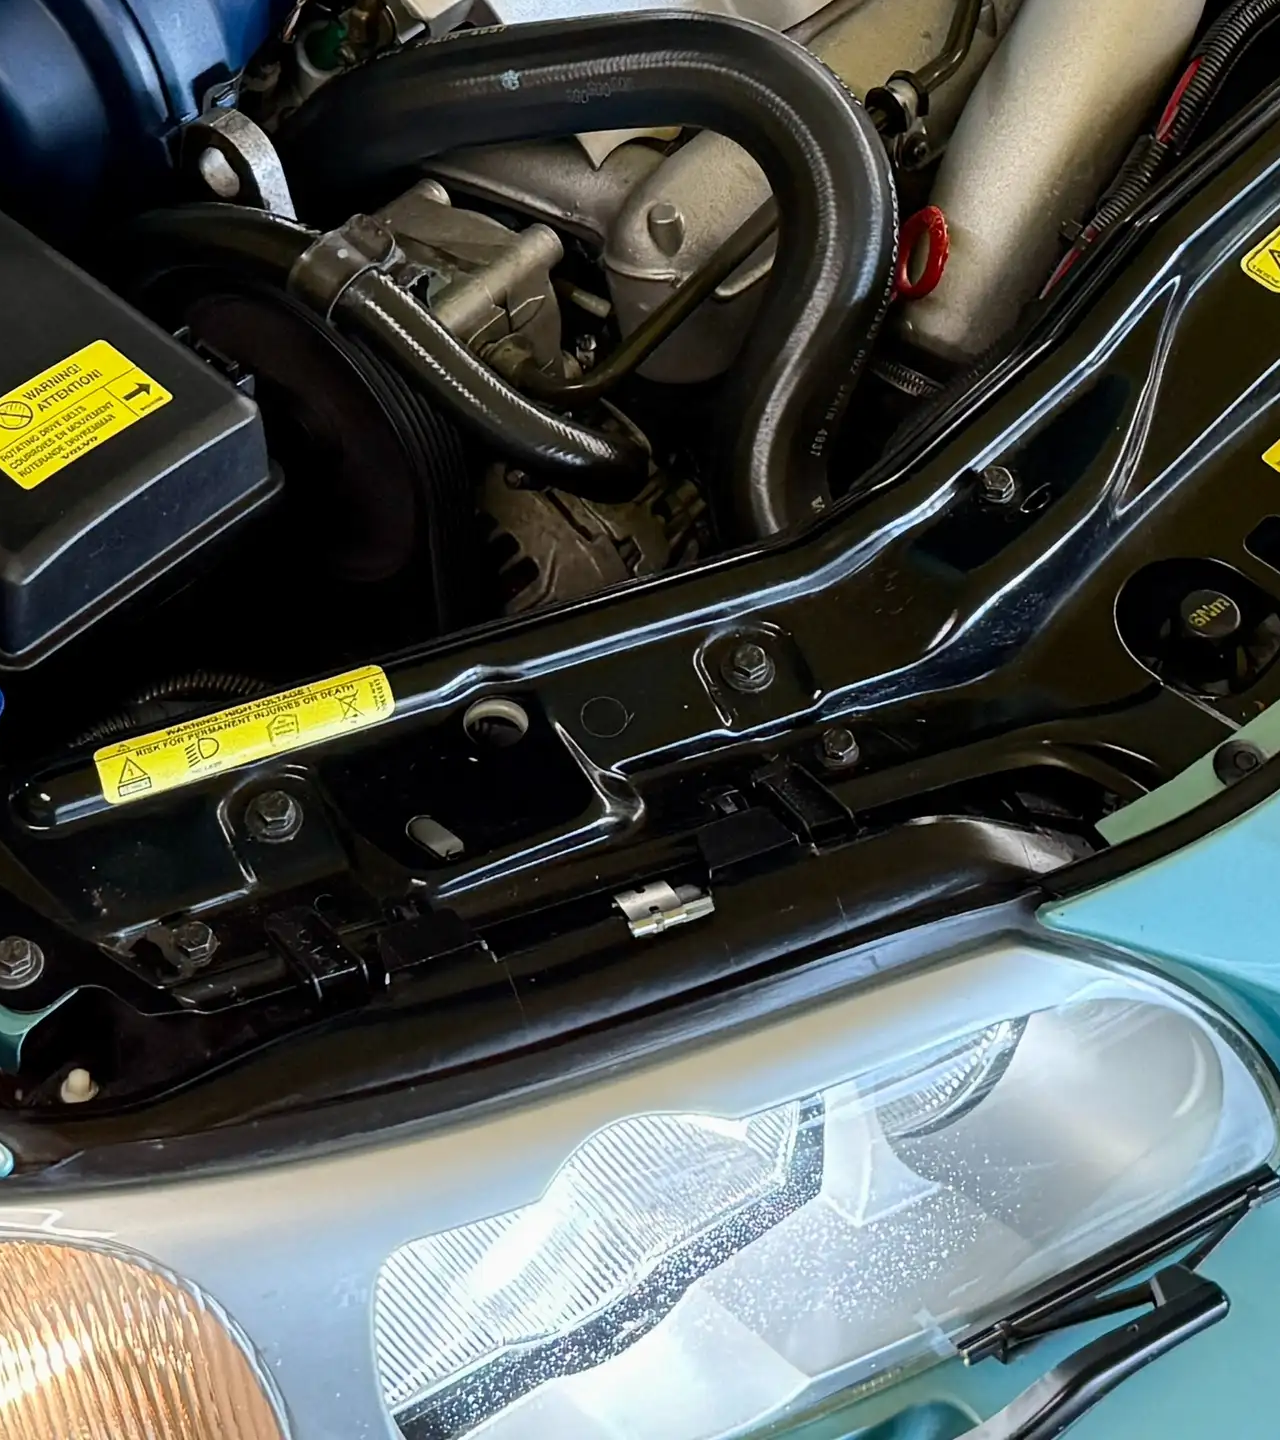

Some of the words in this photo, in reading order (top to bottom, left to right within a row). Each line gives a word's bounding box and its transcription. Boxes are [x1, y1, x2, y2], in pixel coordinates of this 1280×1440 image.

[22, 364, 82, 400] WARNING!
[37, 369, 103, 412] ATTENTION!
[0, 435, 40, 462] ROTATING
[61, 436, 97, 459] VOLVO
[136, 743, 160, 756] RISK
[163, 735, 184, 748] FOR
[188, 714, 250, 740] PERMANENT
[254, 700, 300, 719] INJURIES
[303, 693, 318, 704] OR
[320, 682, 354, 699] DEATH
[224, 706, 252, 717] HIGH
[254, 689, 305, 708] VOLTAGE
